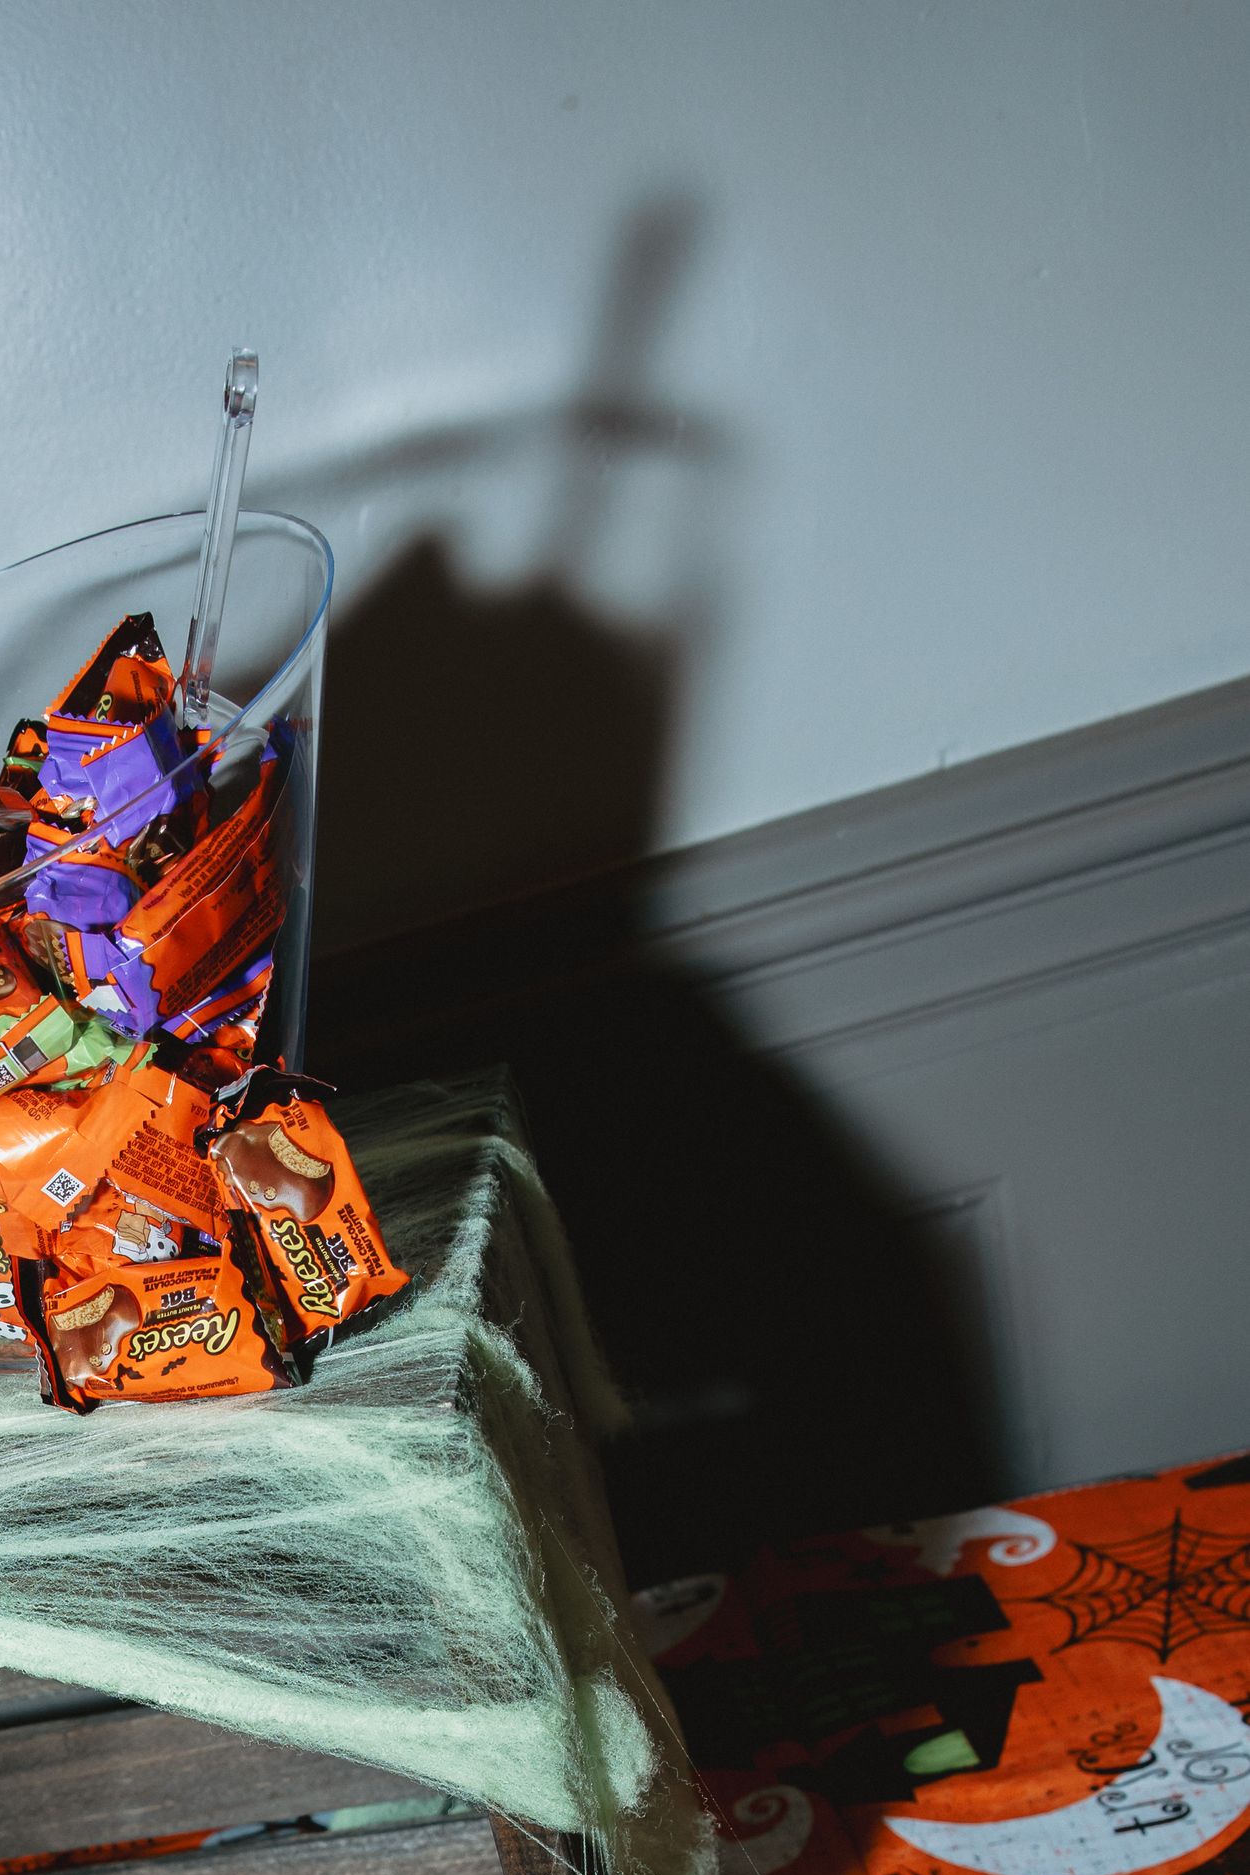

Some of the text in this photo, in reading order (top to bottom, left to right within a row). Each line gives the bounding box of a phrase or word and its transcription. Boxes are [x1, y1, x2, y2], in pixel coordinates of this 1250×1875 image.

[345, 1203, 364, 1237] BUTTER
[337, 1209, 366, 1258] CHOCOLATE
[315, 1236, 330, 1260] BUTTER
[326, 1232, 358, 1274] Bat
[364, 1236, 383, 1269] PEANUT
[142, 1271, 177, 1285] BUTTER
[179, 1267, 213, 1280] PEANUT
[269, 1217, 341, 1319] Reese's
[144, 1273, 217, 1293] MILK CHOCOLATE
[161, 1286, 197, 1310] Bat
[156, 1309, 179, 1320] BUTTER
[127, 1307, 241, 1363] Reese's
[196, 1376, 240, 1392] comments?
